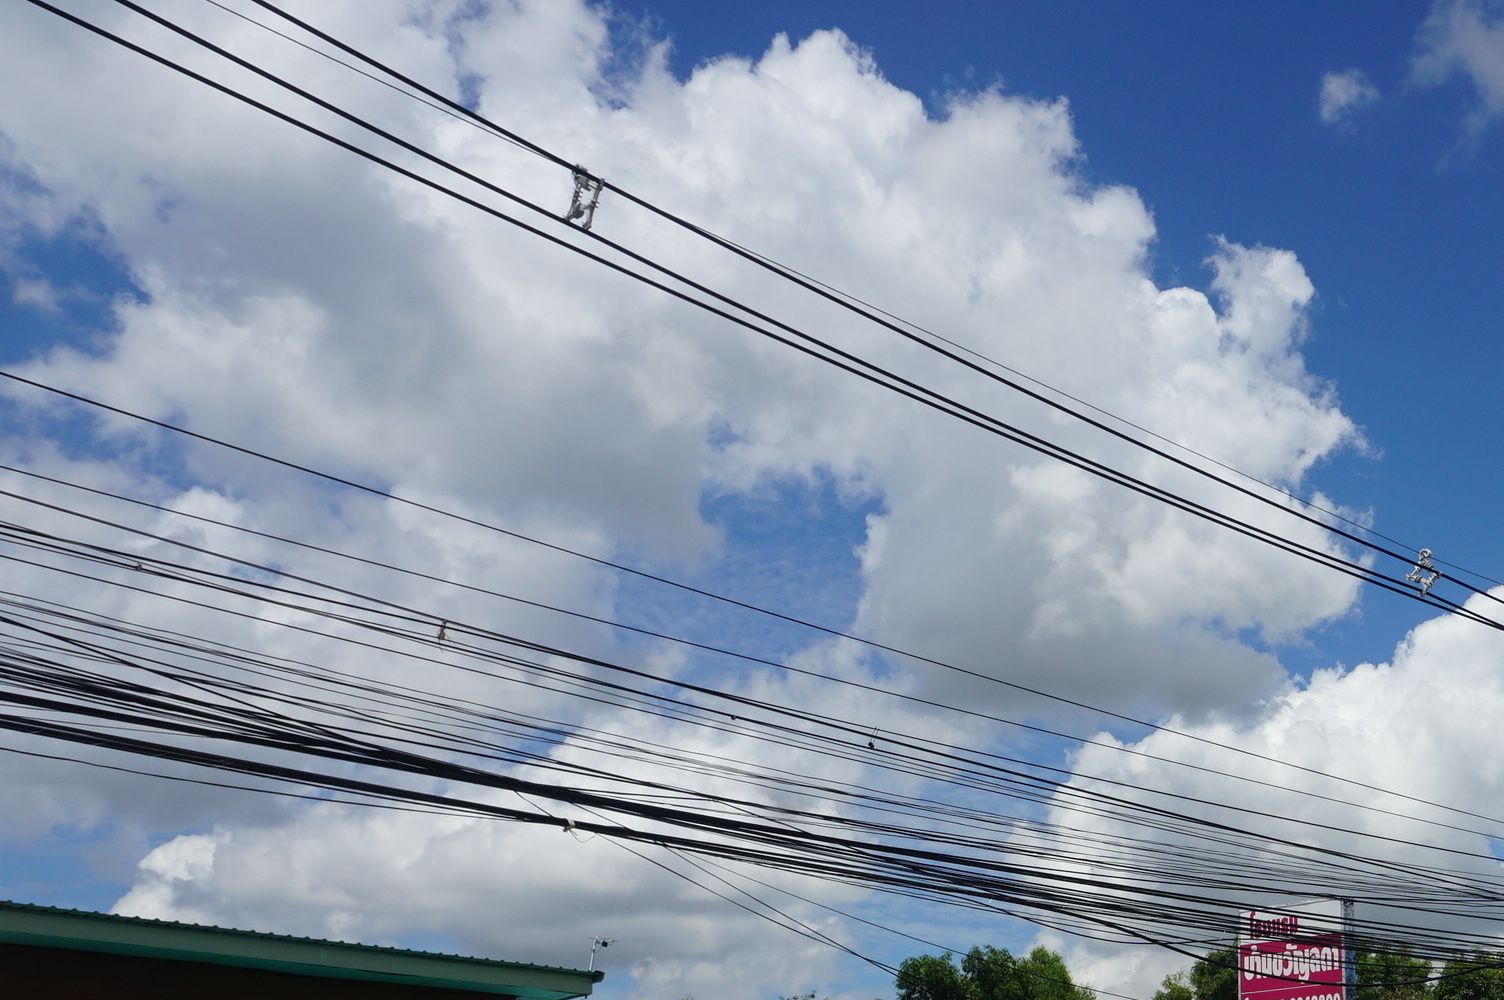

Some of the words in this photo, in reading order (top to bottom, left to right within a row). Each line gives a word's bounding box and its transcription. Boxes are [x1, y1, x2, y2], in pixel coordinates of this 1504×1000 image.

[1243, 943, 1339, 984] บ้านขวัญลดา
